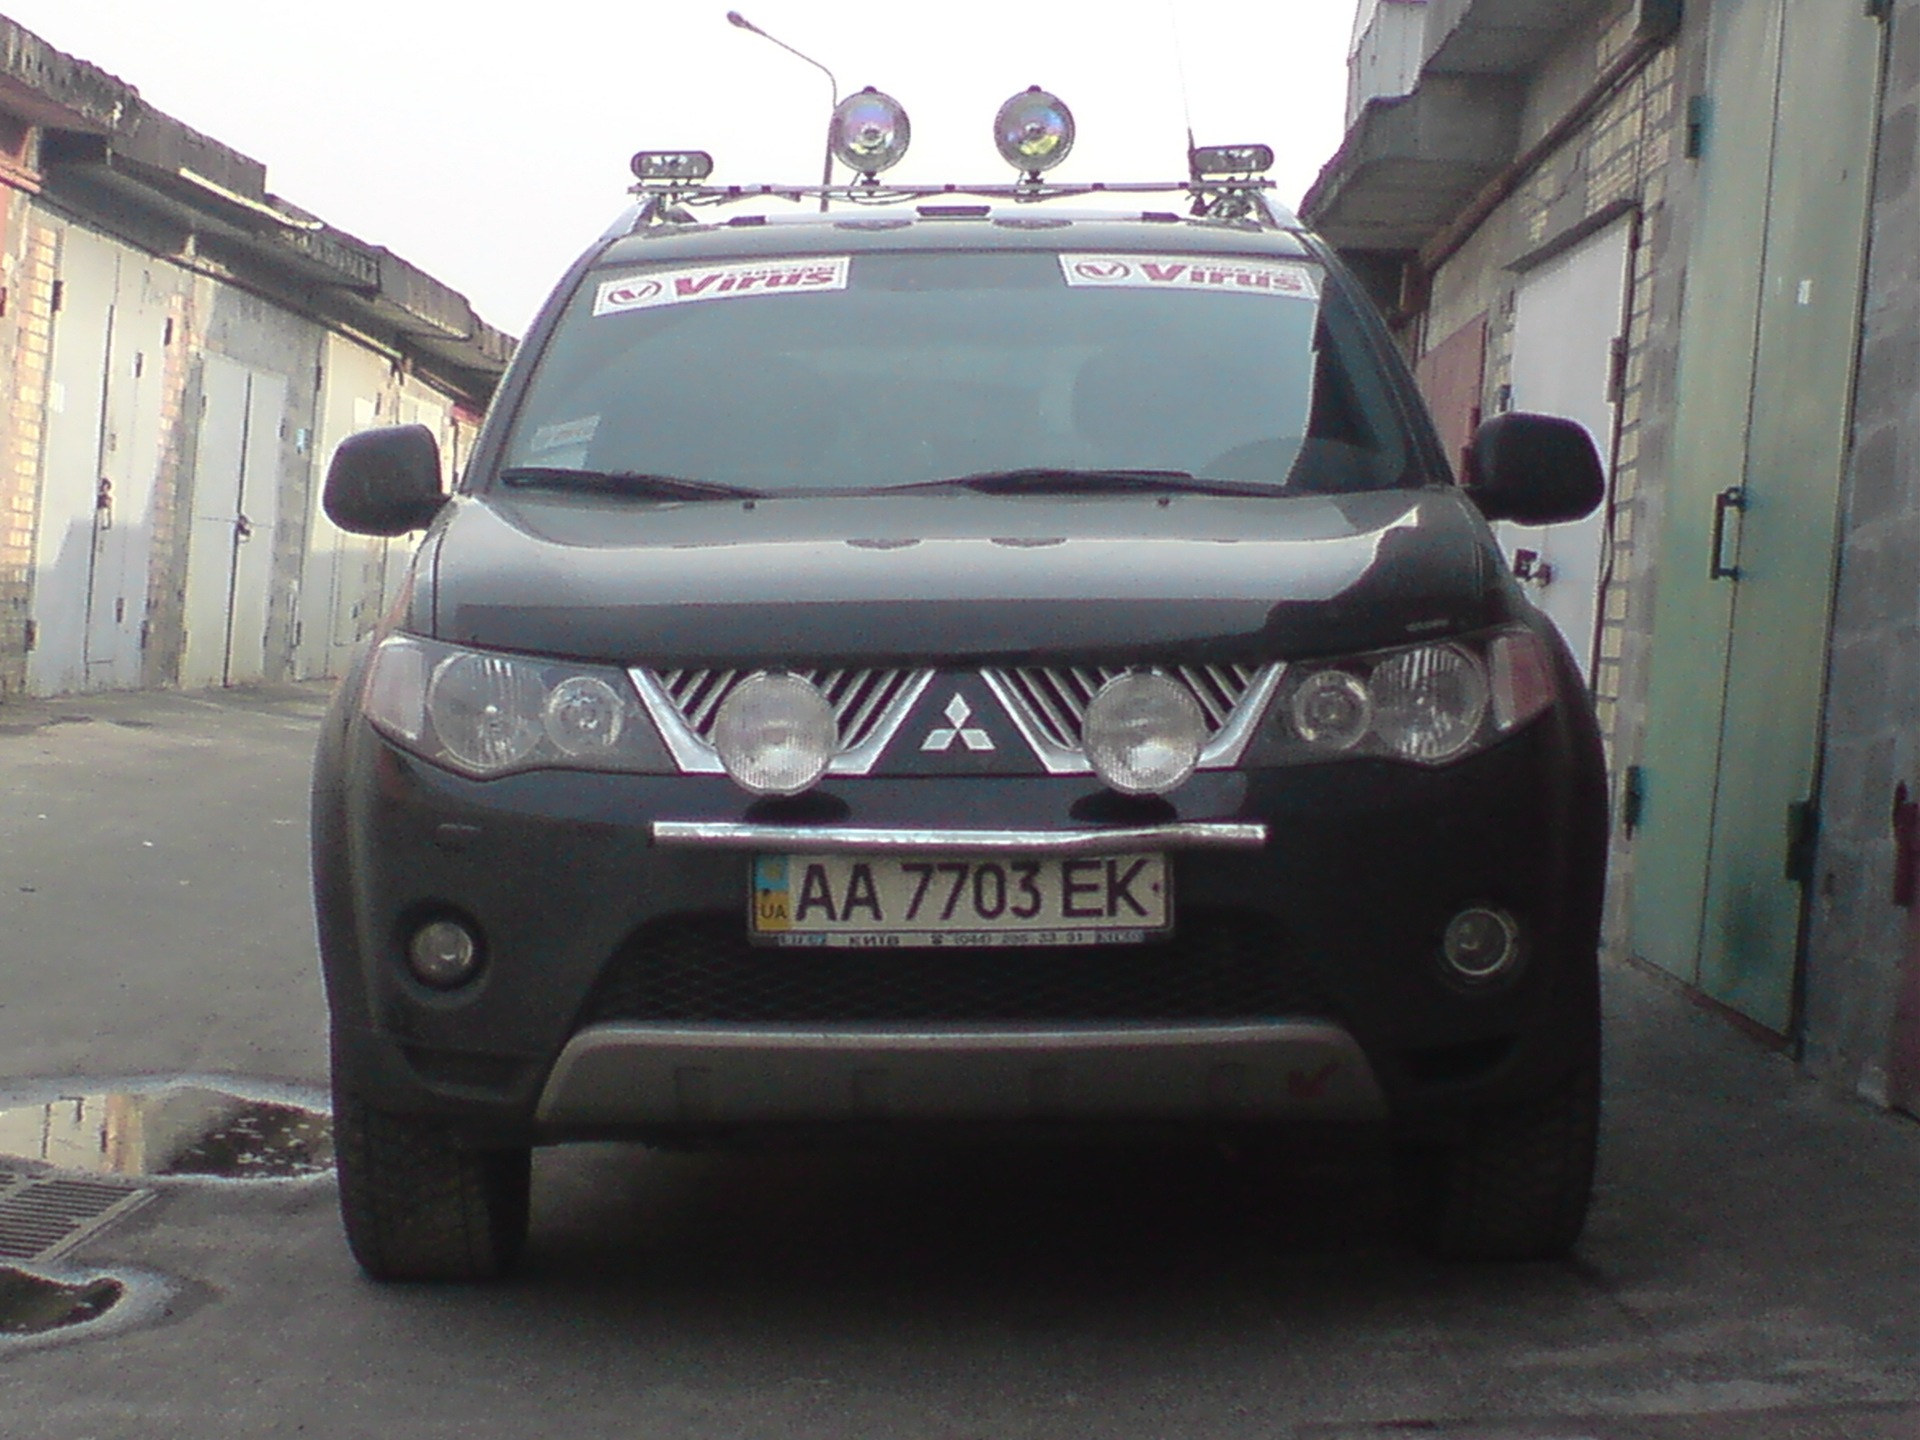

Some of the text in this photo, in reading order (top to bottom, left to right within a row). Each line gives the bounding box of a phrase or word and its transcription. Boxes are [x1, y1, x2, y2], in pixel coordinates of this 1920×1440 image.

[675, 273, 833, 296] Virus
[1140, 263, 1302, 291] Virus
[796, 859, 1148, 921] AA 7703 EK
[761, 904, 788, 921] UA
